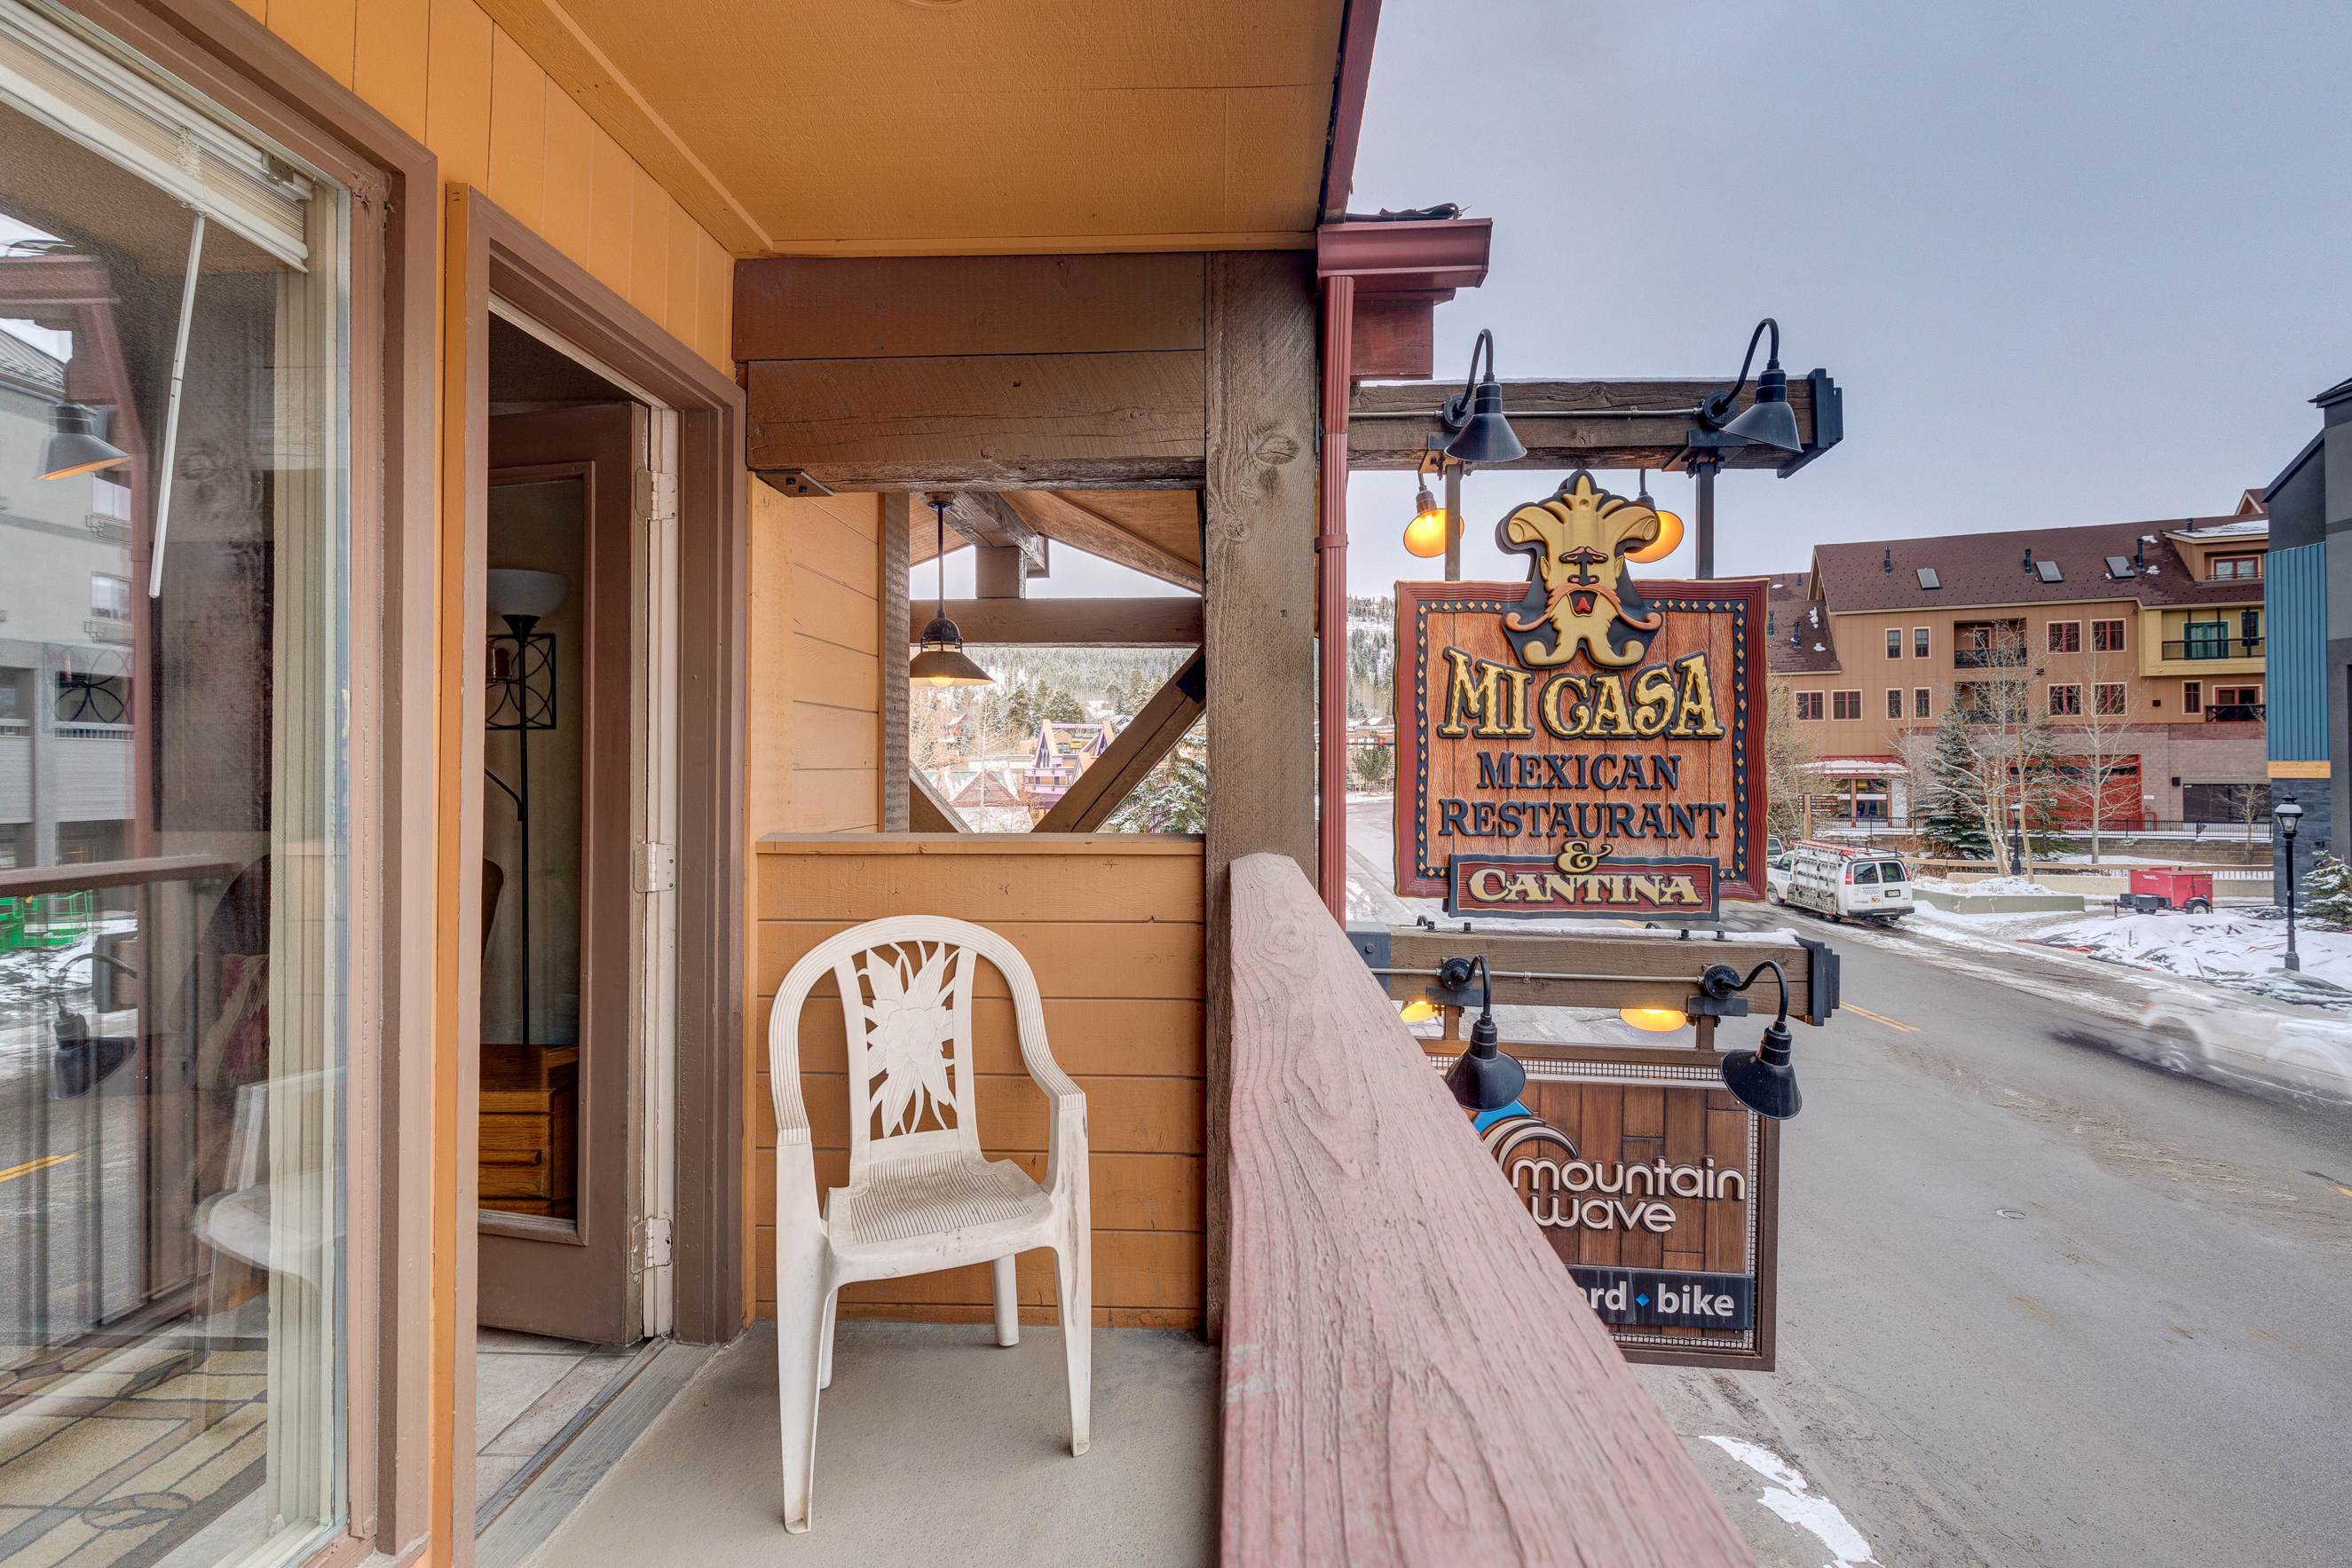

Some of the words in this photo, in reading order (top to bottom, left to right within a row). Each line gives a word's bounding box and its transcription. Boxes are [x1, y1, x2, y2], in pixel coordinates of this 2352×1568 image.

[1440, 648, 1534, 738] MI
[1541, 652, 1725, 739] CASA
[1477, 752, 1682, 790] MEXICAN
[1440, 799, 1726, 839] RESTAURANT
[1555, 840, 1614, 874] &
[1468, 869, 1704, 907] CANTINA
[1512, 1157, 1745, 1201] mountain
[1532, 1197, 1677, 1233] wave
[1657, 1282, 1735, 1317] bike
